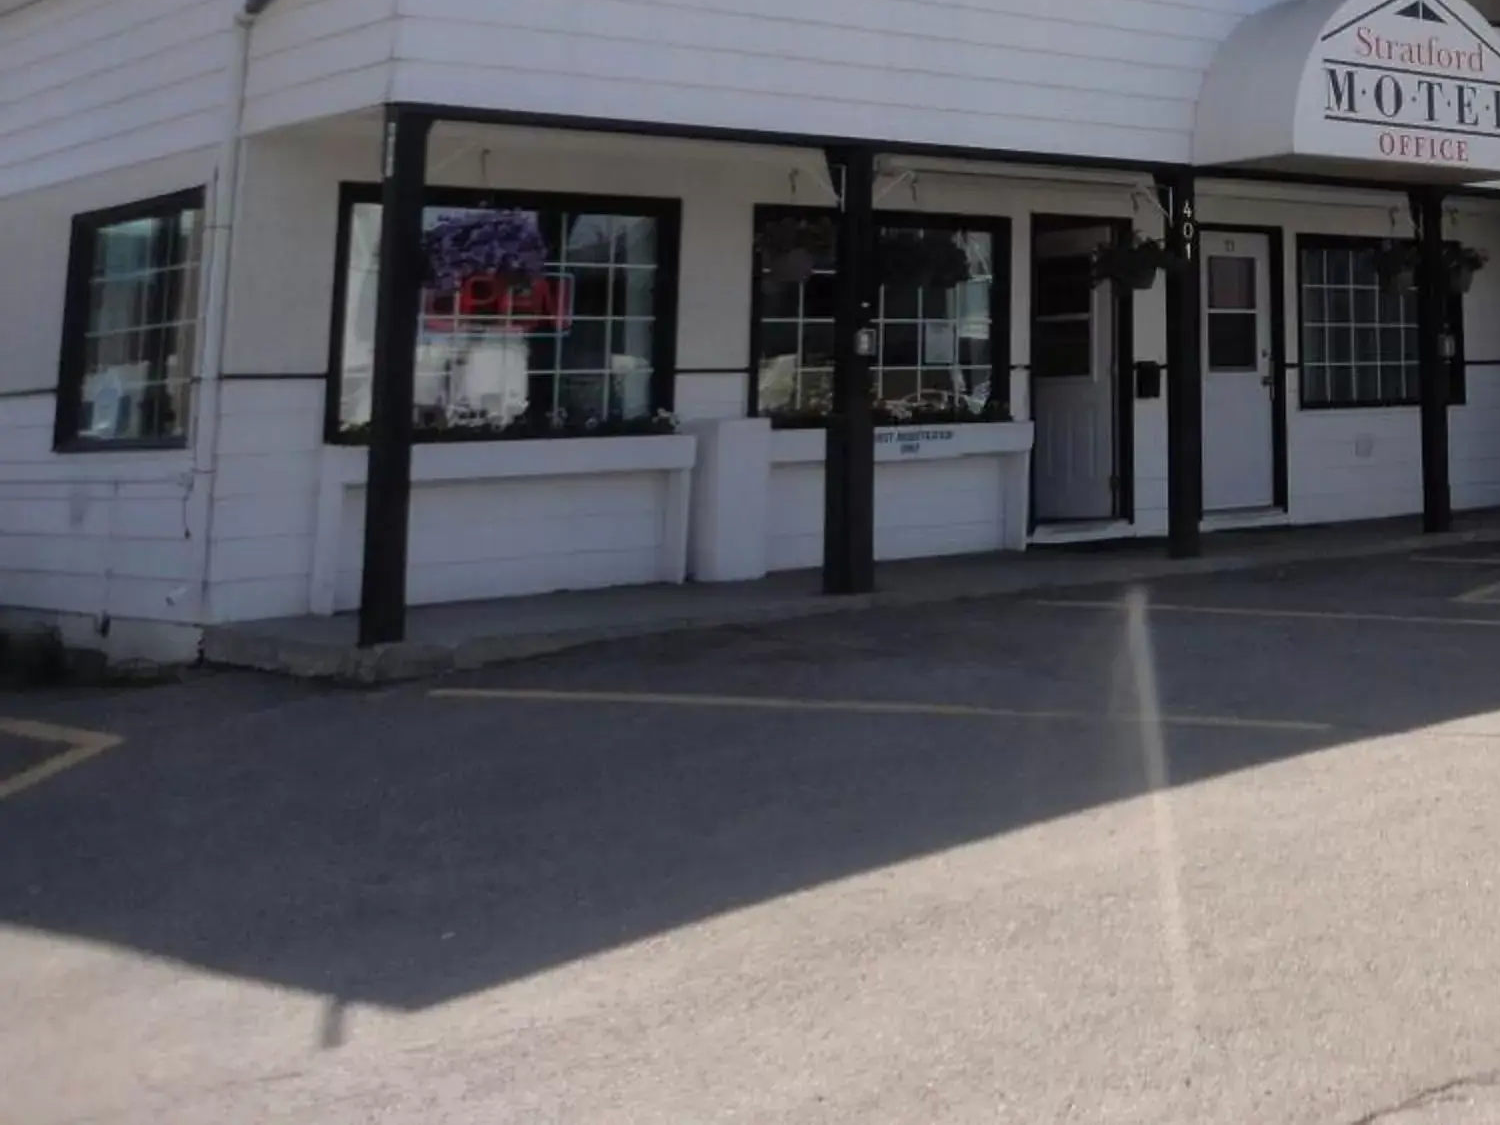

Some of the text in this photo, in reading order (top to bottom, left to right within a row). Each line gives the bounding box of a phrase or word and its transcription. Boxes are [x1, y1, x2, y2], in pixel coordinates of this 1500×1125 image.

[1355, 26, 1484, 72] Stratford
[1378, 131, 1470, 163] OFFICE
[1183, 199, 1194, 262] 401
